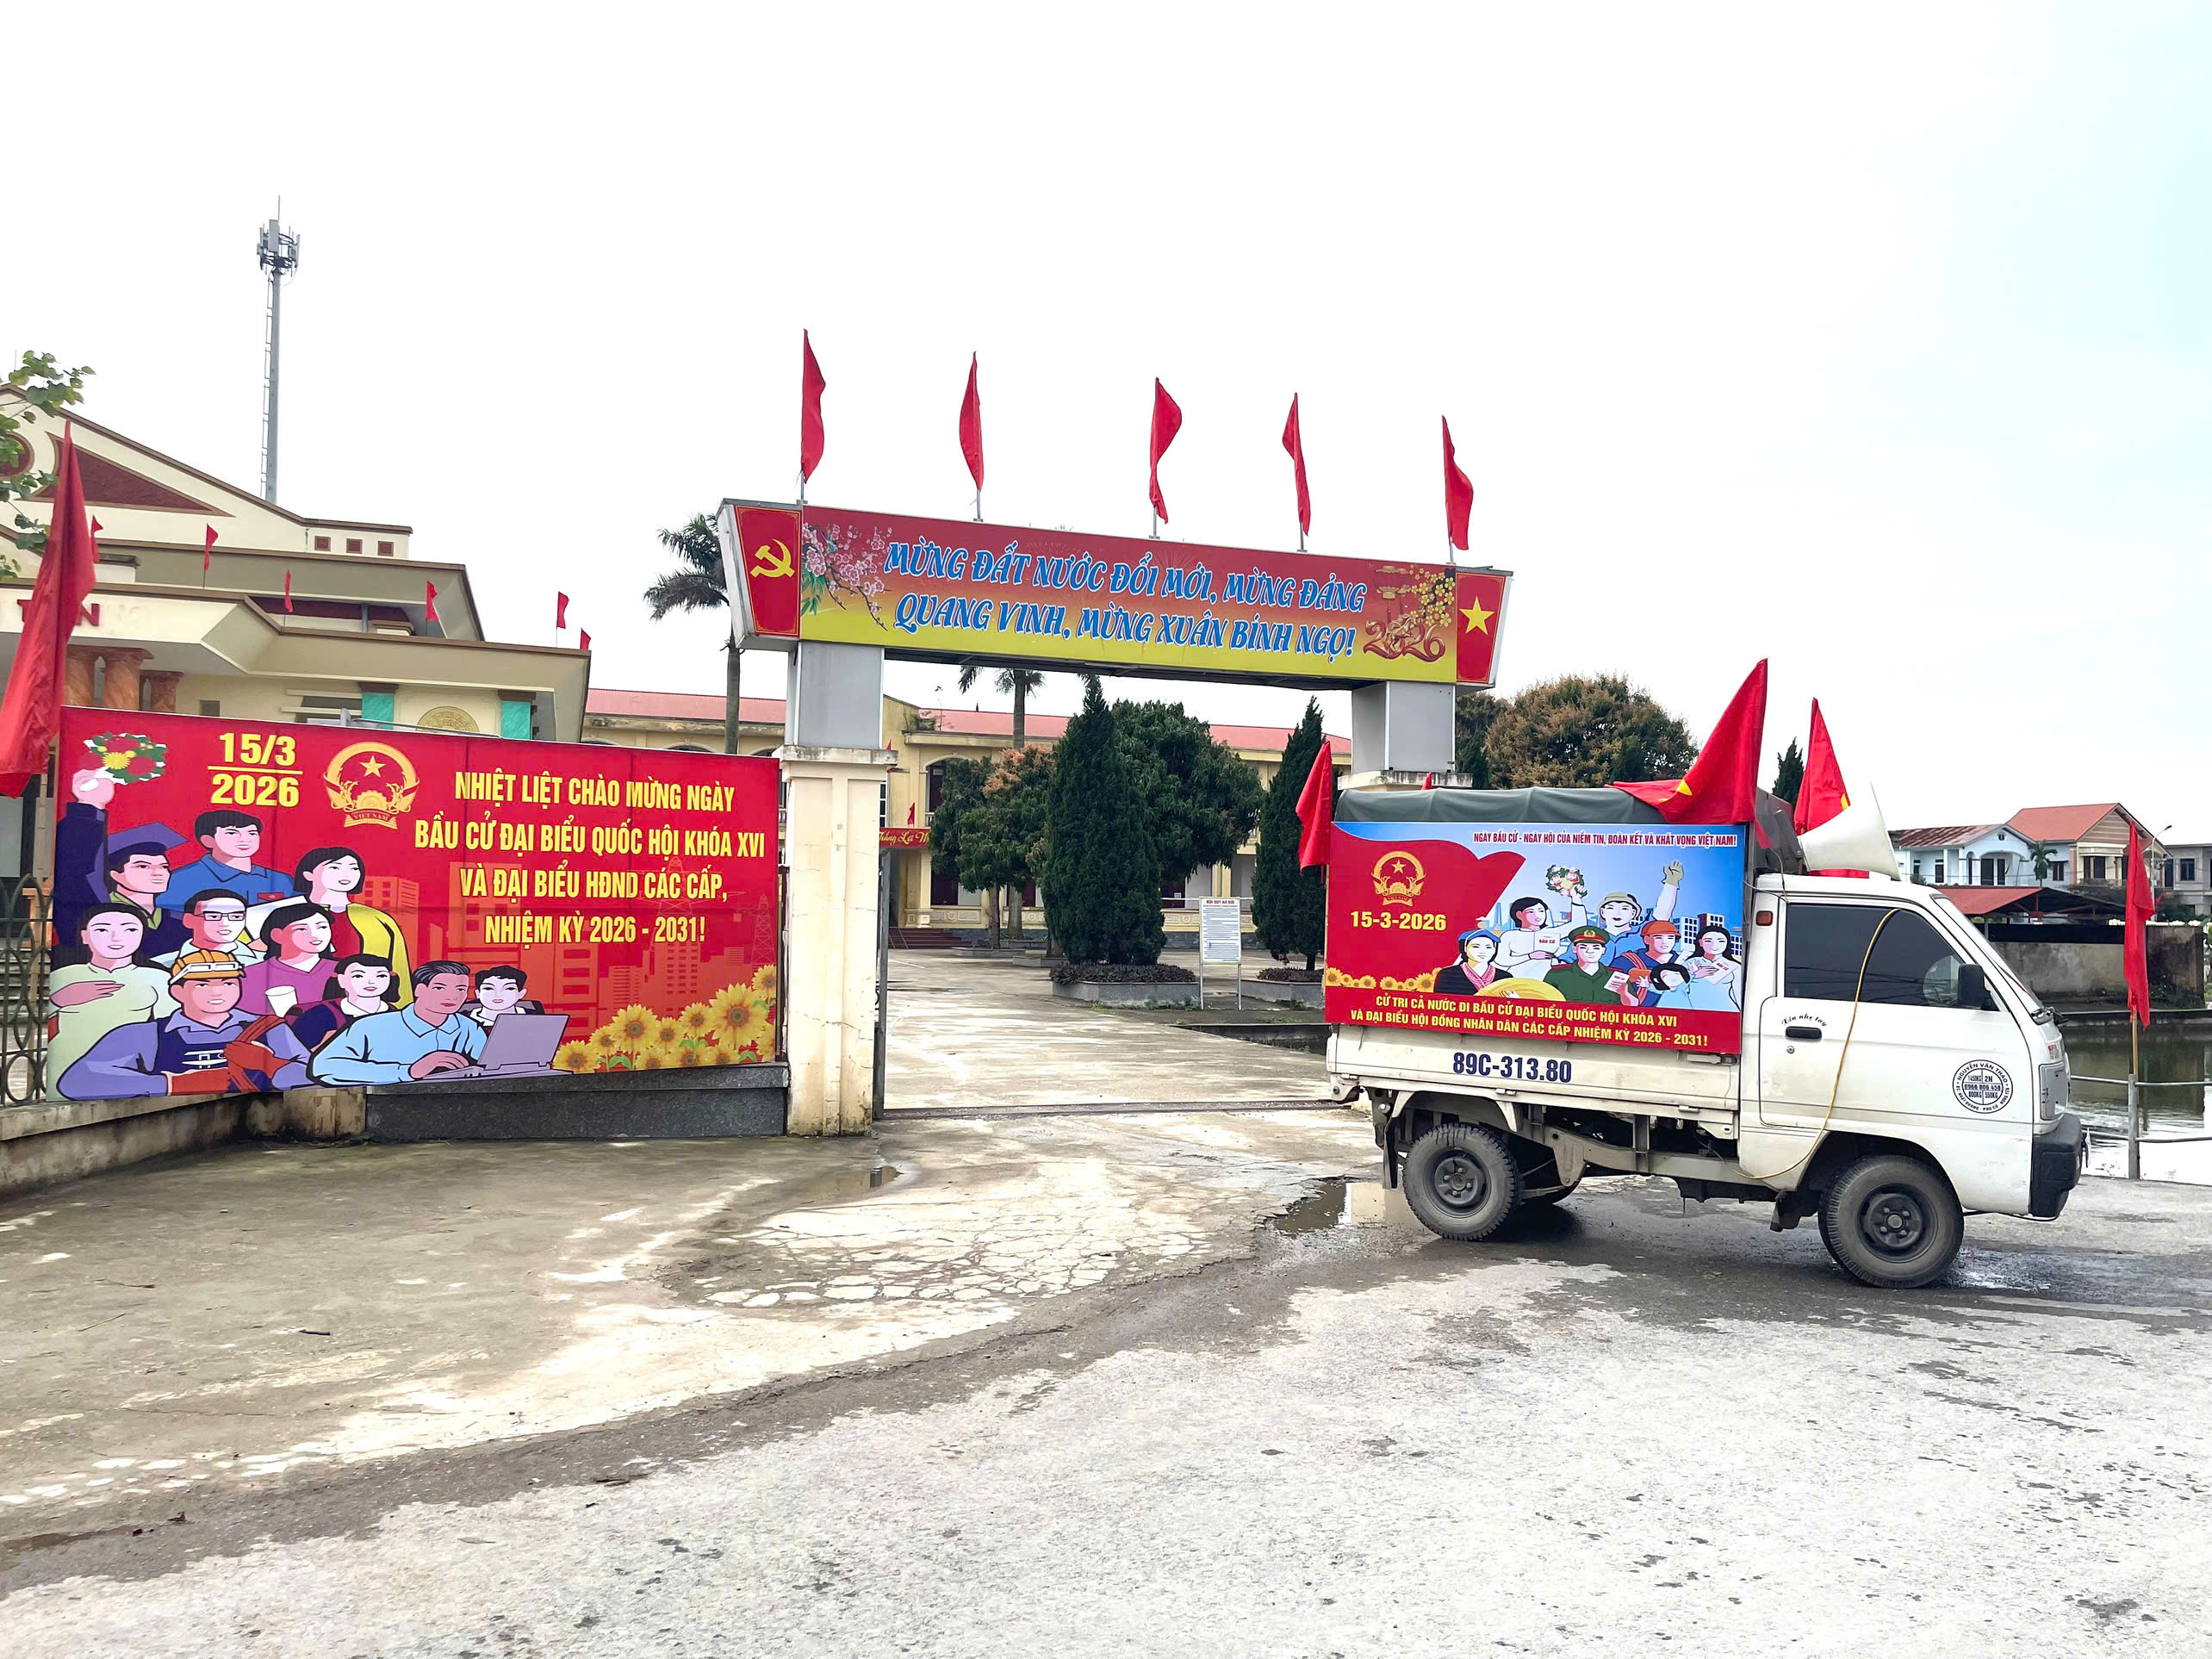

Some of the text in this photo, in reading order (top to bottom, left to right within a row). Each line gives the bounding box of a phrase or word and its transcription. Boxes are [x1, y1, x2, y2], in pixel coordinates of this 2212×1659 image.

[884, 535, 1367, 612] MỪNG ĐẤT NƯỚC ĐỔI MỚI, MỪNG ĐẢNG
[894, 593, 1358, 664] QUANG VINH, MỪNG XUÂN BÍNH NGỌ!
[220, 732, 296, 767] 15/3
[210, 774, 300, 807] 2026
[455, 767, 735, 812] NHIỆT LIỆT CHÀO MỪNG NGÀY
[414, 810, 765, 861] BẦU CỬ ĐẠI BIỂU QUỐC HỘI KHÓA XVI
[1474, 830, 1492, 843] NGÀY
[1507, 829, 1519, 843] CỬ
[1523, 831, 1542, 844] NGÀY
[1543, 830, 1556, 846] HỘI
[1556, 830, 1571, 844] CỦA
[1593, 834, 1606, 845] TIN,
[1607, 832, 1628, 845] ĐOÀN
[1629, 830, 1643, 845] KẾT
[1644, 832, 1654, 845] VÀ
[1656, 832, 1675, 846] KHÁT
[1676, 834, 1696, 848] VỌNG
[1698, 832, 1714, 848] VIỆT
[1715, 835, 1737, 846] NAM!
[459, 859, 728, 904] VÀ ĐẠI BIỂU HĐND CÁC CẤP,
[485, 910, 553, 949] NHIỆM
[559, 910, 585, 943] KỲ
[589, 916, 637, 943] 2026
[654, 916, 705, 943] 2031!
[1351, 910, 1446, 931] 15-3-2026
[1351, 1009, 1364, 1021] VÀ
[1365, 1010, 1382, 1023] ĐẠI
[1385, 1010, 1408, 1024] BIỂU
[1411, 1012, 1429, 1027] HỘI
[1432, 1014, 1460, 1028] ĐỒNG
[1463, 1016, 1494, 1030] NHÂN
[1496, 1019, 1519, 1033] DÂN
[1522, 1021, 1544, 1034] CÁC
[1548, 1022, 1570, 1036] CẤP
[1574, 1026, 1612, 1041] NHIỆM
[1615, 1028, 1631, 1041] KỲ
[1633, 1031, 1662, 1043] 2026
[1674, 1034, 1708, 1047] 2031!
[1376, 992, 1391, 1007] CỬ
[1392, 997, 1408, 1008] TRI
[1411, 995, 1426, 1010] CẢ
[1427, 998, 1456, 1012] NƯỚC
[1459, 1002, 1469, 1012] ĐI
[1498, 1000, 1513, 1016] CỬ
[1515, 1006, 1533, 1019] ĐẠI
[1537, 1003, 1563, 1019] BIỂU
[1566, 1007, 1596, 1022] QUỐC
[1600, 1010, 1619, 1025] HỘI
[1623, 1012, 1654, 1026] KHÓA
[1658, 1015, 1677, 1027] XVI
[1452, 1052, 1572, 1083] 89C-313.80
